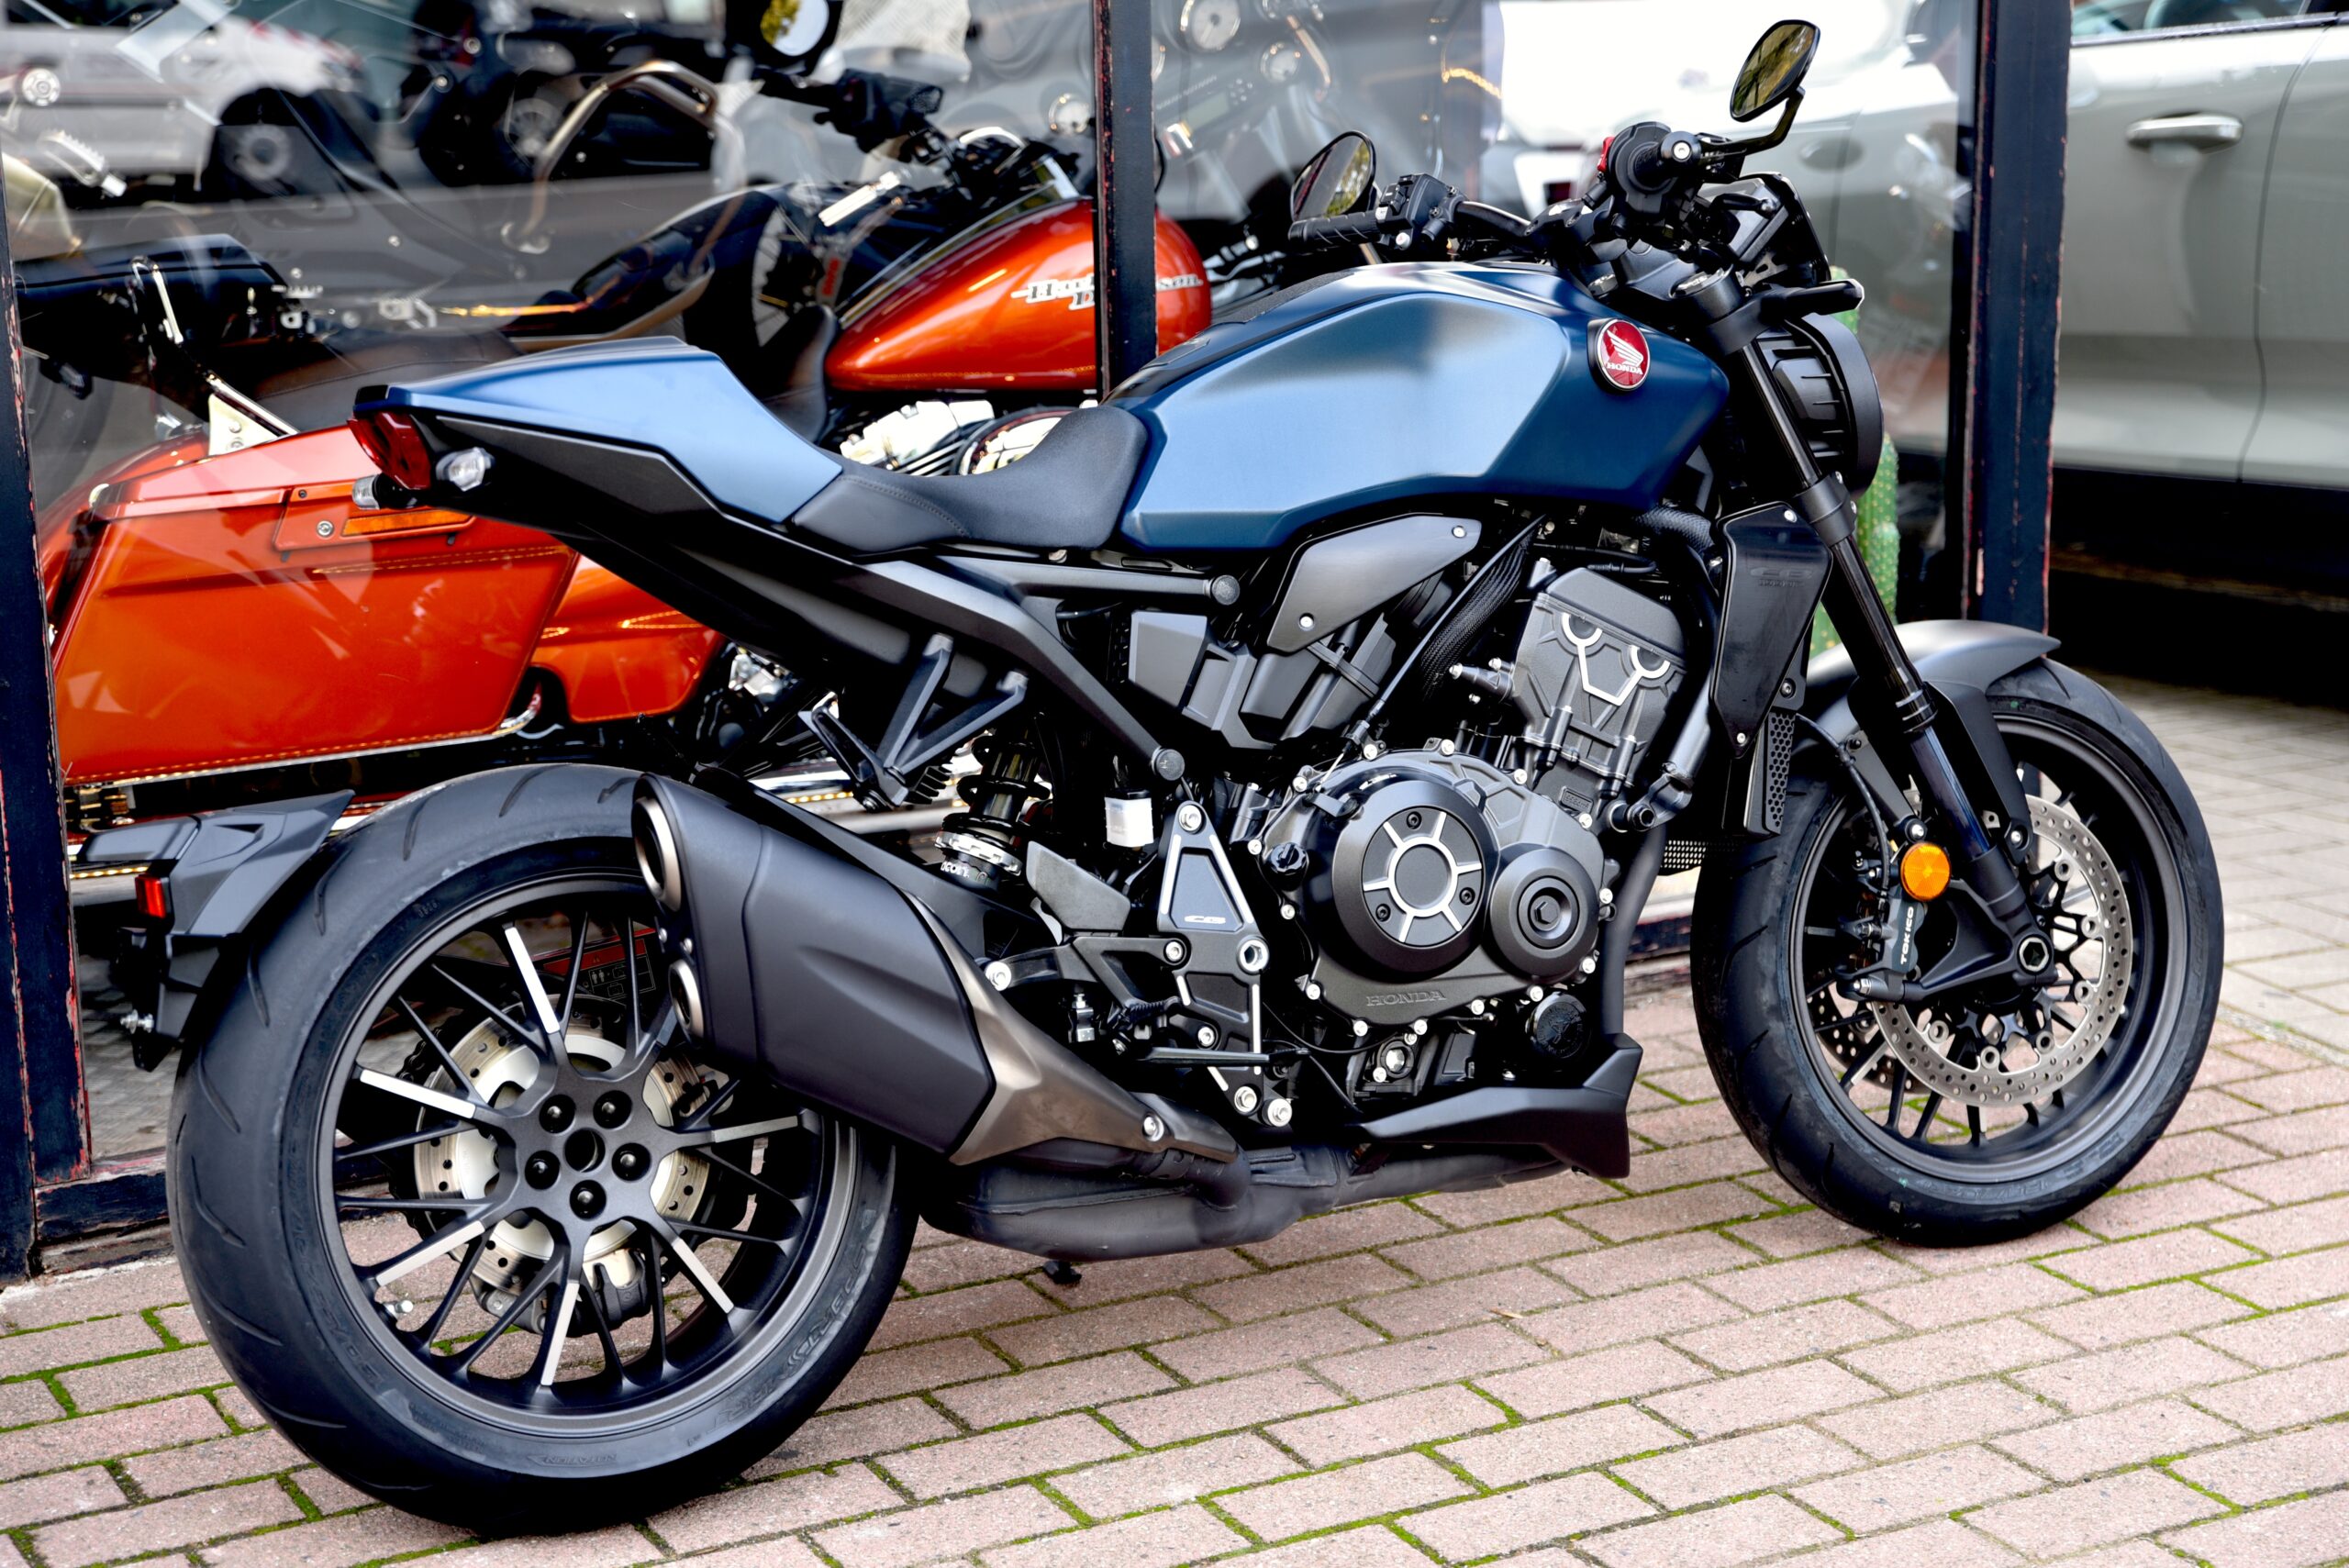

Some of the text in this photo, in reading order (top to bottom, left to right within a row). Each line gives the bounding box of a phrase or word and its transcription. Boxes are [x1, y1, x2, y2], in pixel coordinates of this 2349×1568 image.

[1607, 361, 1643, 375] HONDA
[1900, 906, 1914, 965] TOKICO
[1365, 990, 1447, 1006] HONDA
